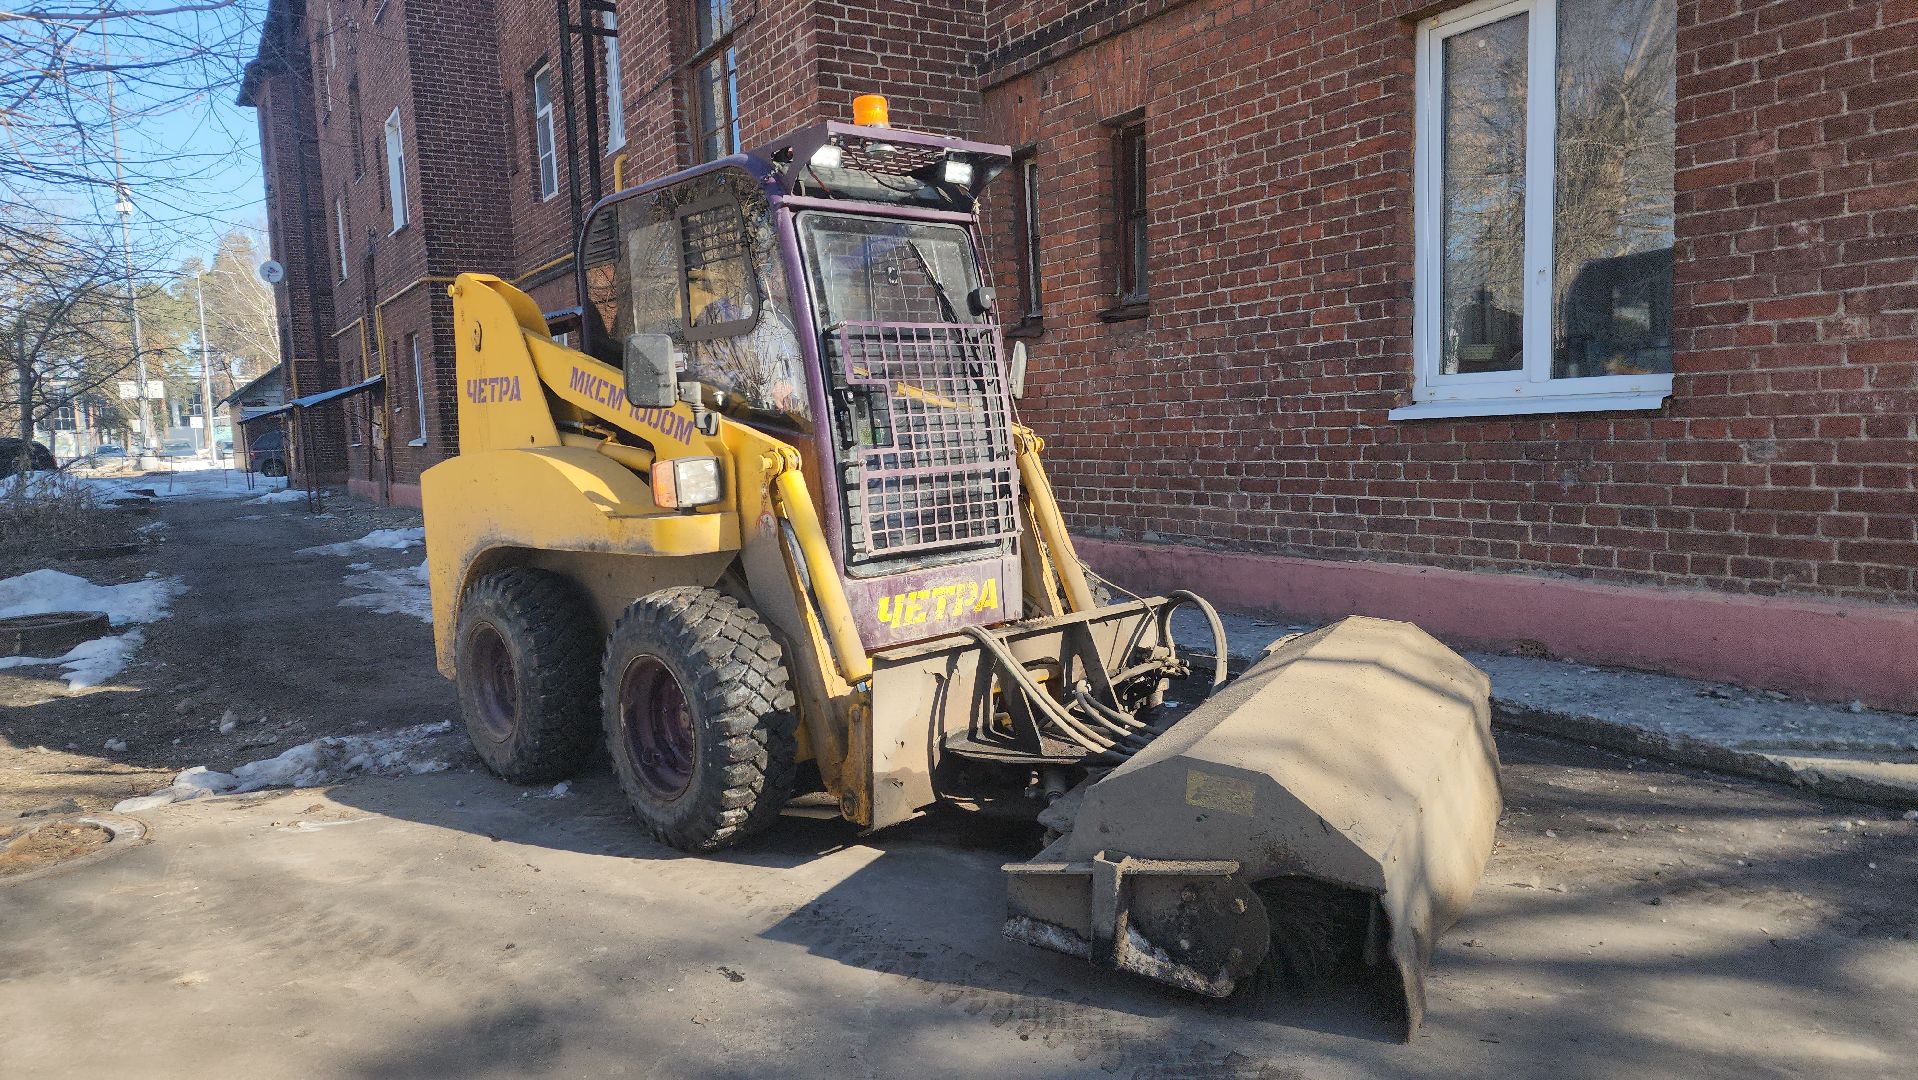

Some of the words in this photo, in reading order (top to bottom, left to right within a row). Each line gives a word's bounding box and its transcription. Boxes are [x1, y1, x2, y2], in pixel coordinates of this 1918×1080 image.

[466, 375, 522, 404] ЧЕТРА
[569, 366, 626, 412] МКСМ
[877, 577, 998, 629] ЧЕТРА
